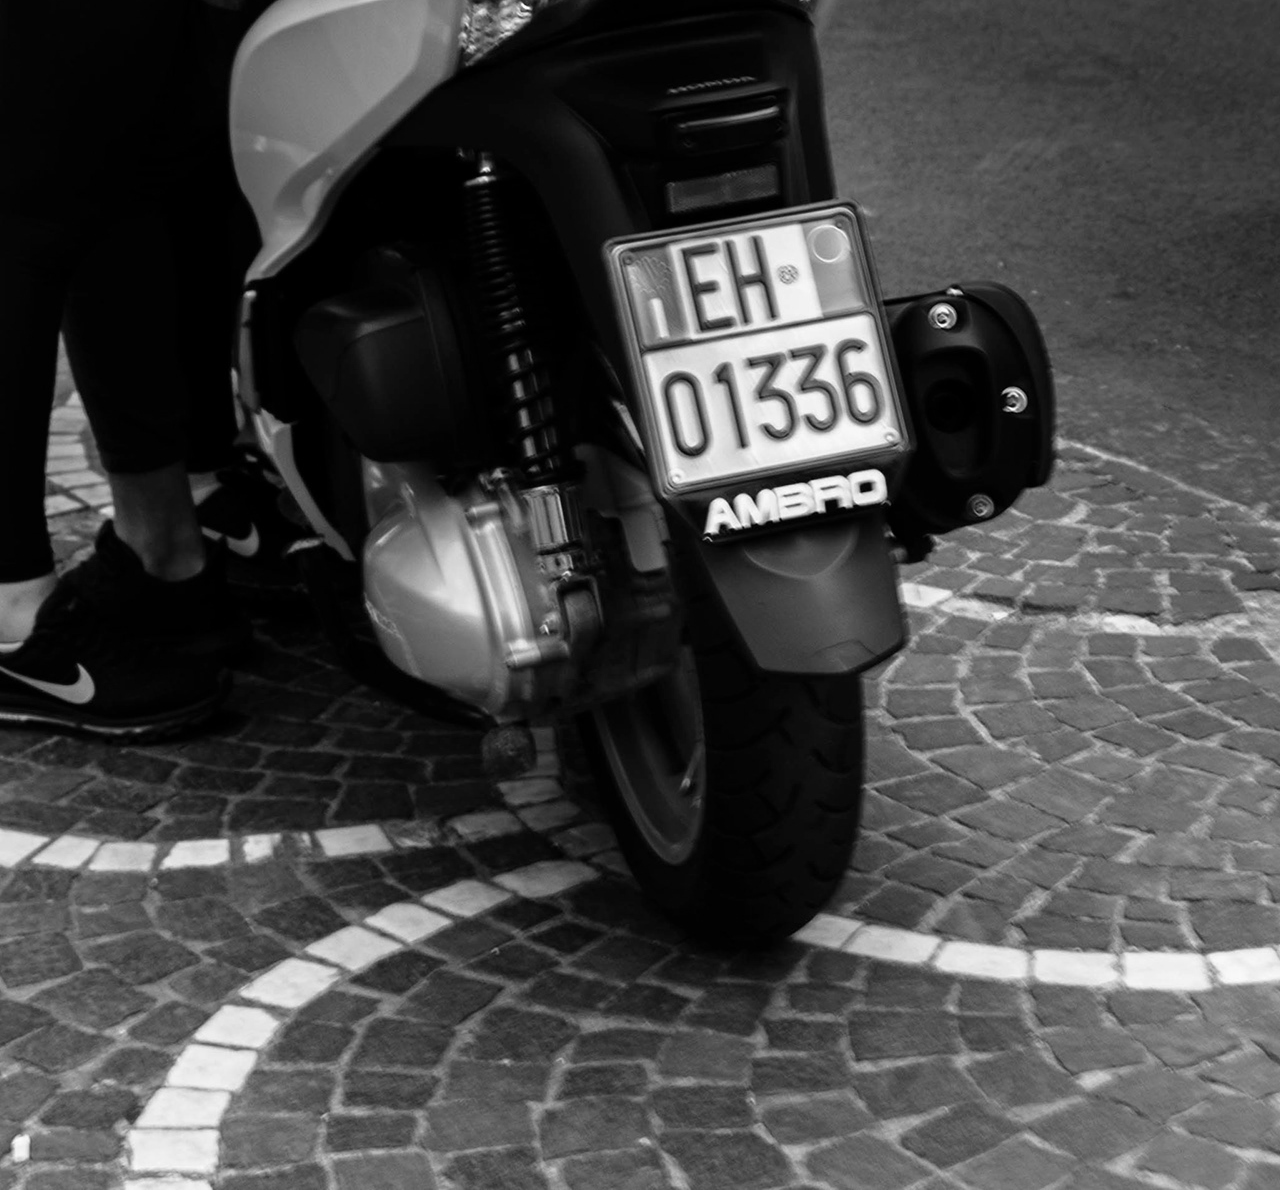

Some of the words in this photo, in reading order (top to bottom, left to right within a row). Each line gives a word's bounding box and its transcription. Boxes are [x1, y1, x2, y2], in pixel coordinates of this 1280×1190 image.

[681, 235, 778, 331] EH
[661, 338, 884, 458] 01336
[704, 468, 888, 538] AMBRO
